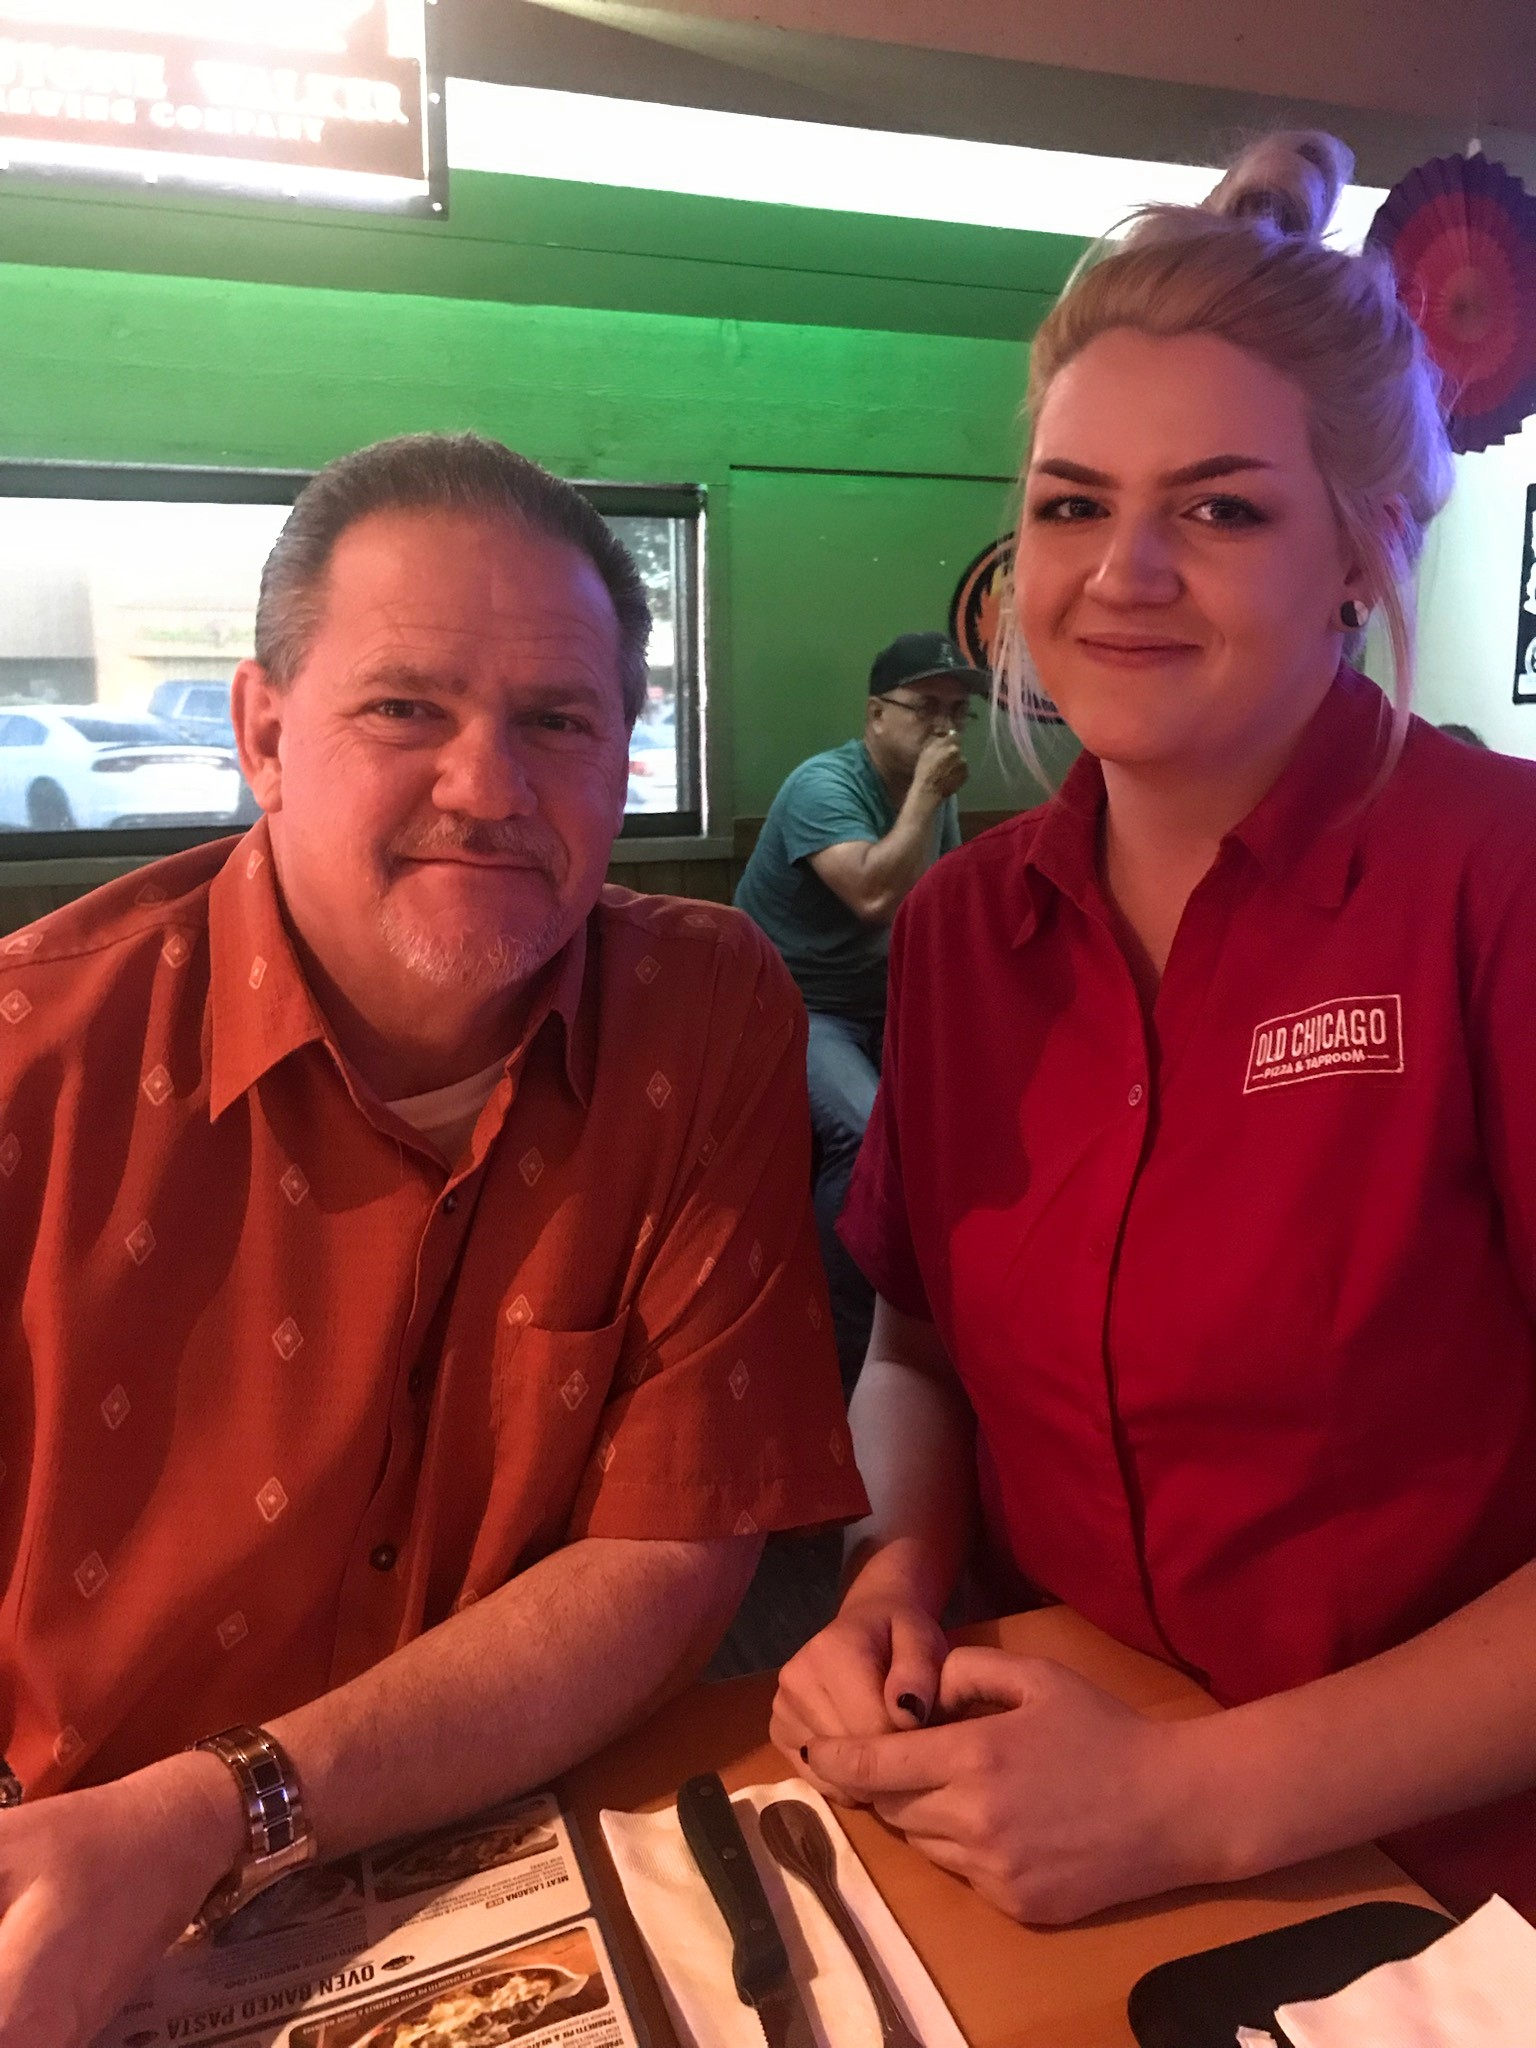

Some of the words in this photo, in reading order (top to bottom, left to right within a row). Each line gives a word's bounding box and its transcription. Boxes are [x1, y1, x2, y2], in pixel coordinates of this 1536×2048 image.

[150, 101, 325, 143] COMPANY
[1256, 1027, 1287, 1066] OLD
[1291, 1008, 1387, 1057] CHICAGO
[1264, 1063, 1293, 1079] PIZZA
[1295, 1061, 1305, 1074] &
[1305, 1049, 1366, 1071] TAPROOM
[505, 1883, 544, 1901] LASAGNA
[546, 1875, 569, 1887] MEAT
[319, 1964, 375, 1994] OVEN
[241, 1984, 311, 2019] BAKED
[167, 2006, 235, 2038] PASTA
